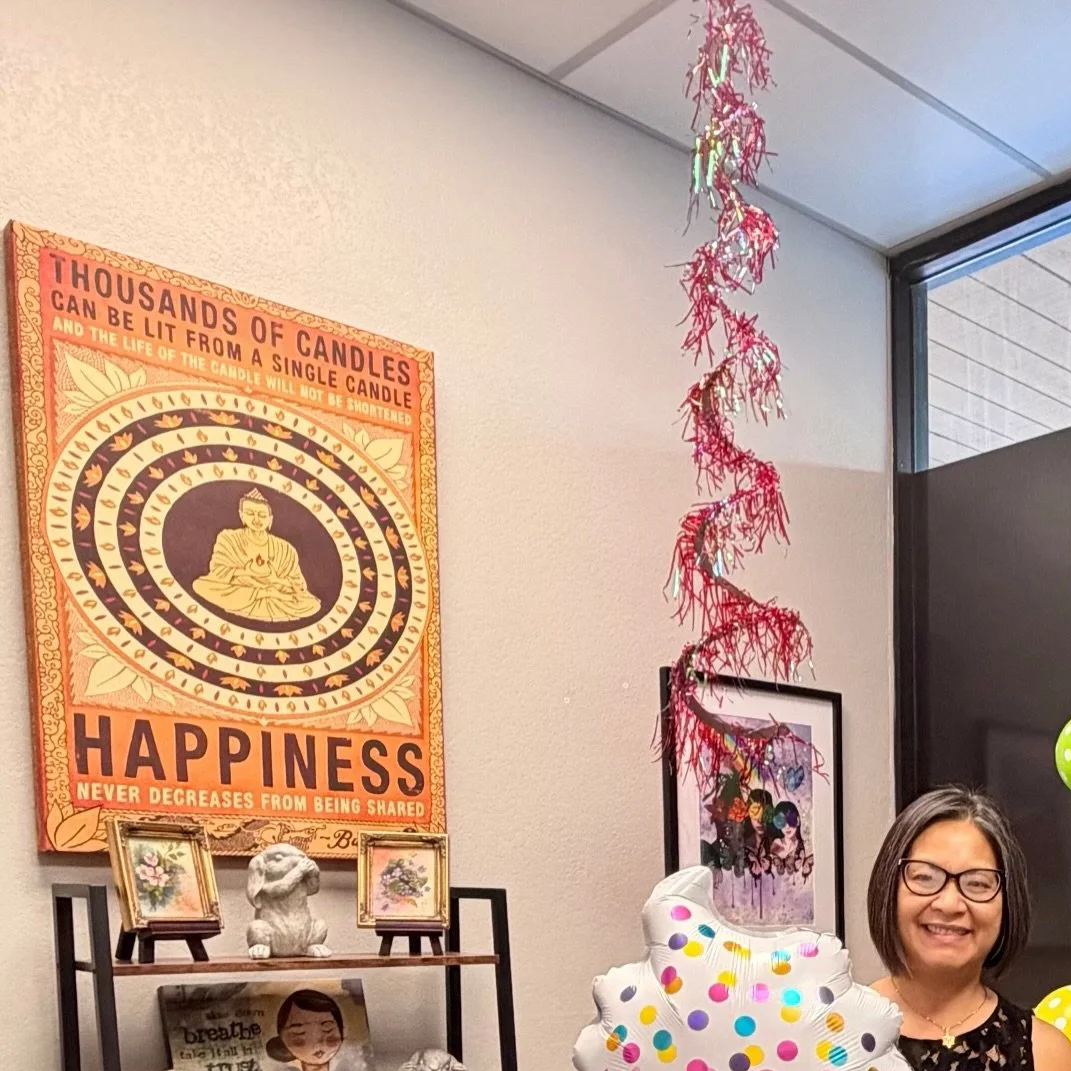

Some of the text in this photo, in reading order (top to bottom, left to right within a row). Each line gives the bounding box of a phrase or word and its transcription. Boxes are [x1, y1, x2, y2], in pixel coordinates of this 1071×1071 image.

[49, 253, 411, 386] THOUSANDS OF CANDLES
[51, 290, 412, 409] CAN BE LIT FROM A SINGLE CANDLE
[52, 316, 412, 426] AND THE LIFE OF THE CANDLE WILL NOT BE SHORTENED
[74, 713, 425, 797] HAPPINESS
[76, 781, 425, 818] NEVER DECREASES FROM BEING SHARED
[182, 1021, 262, 1044] breathe
